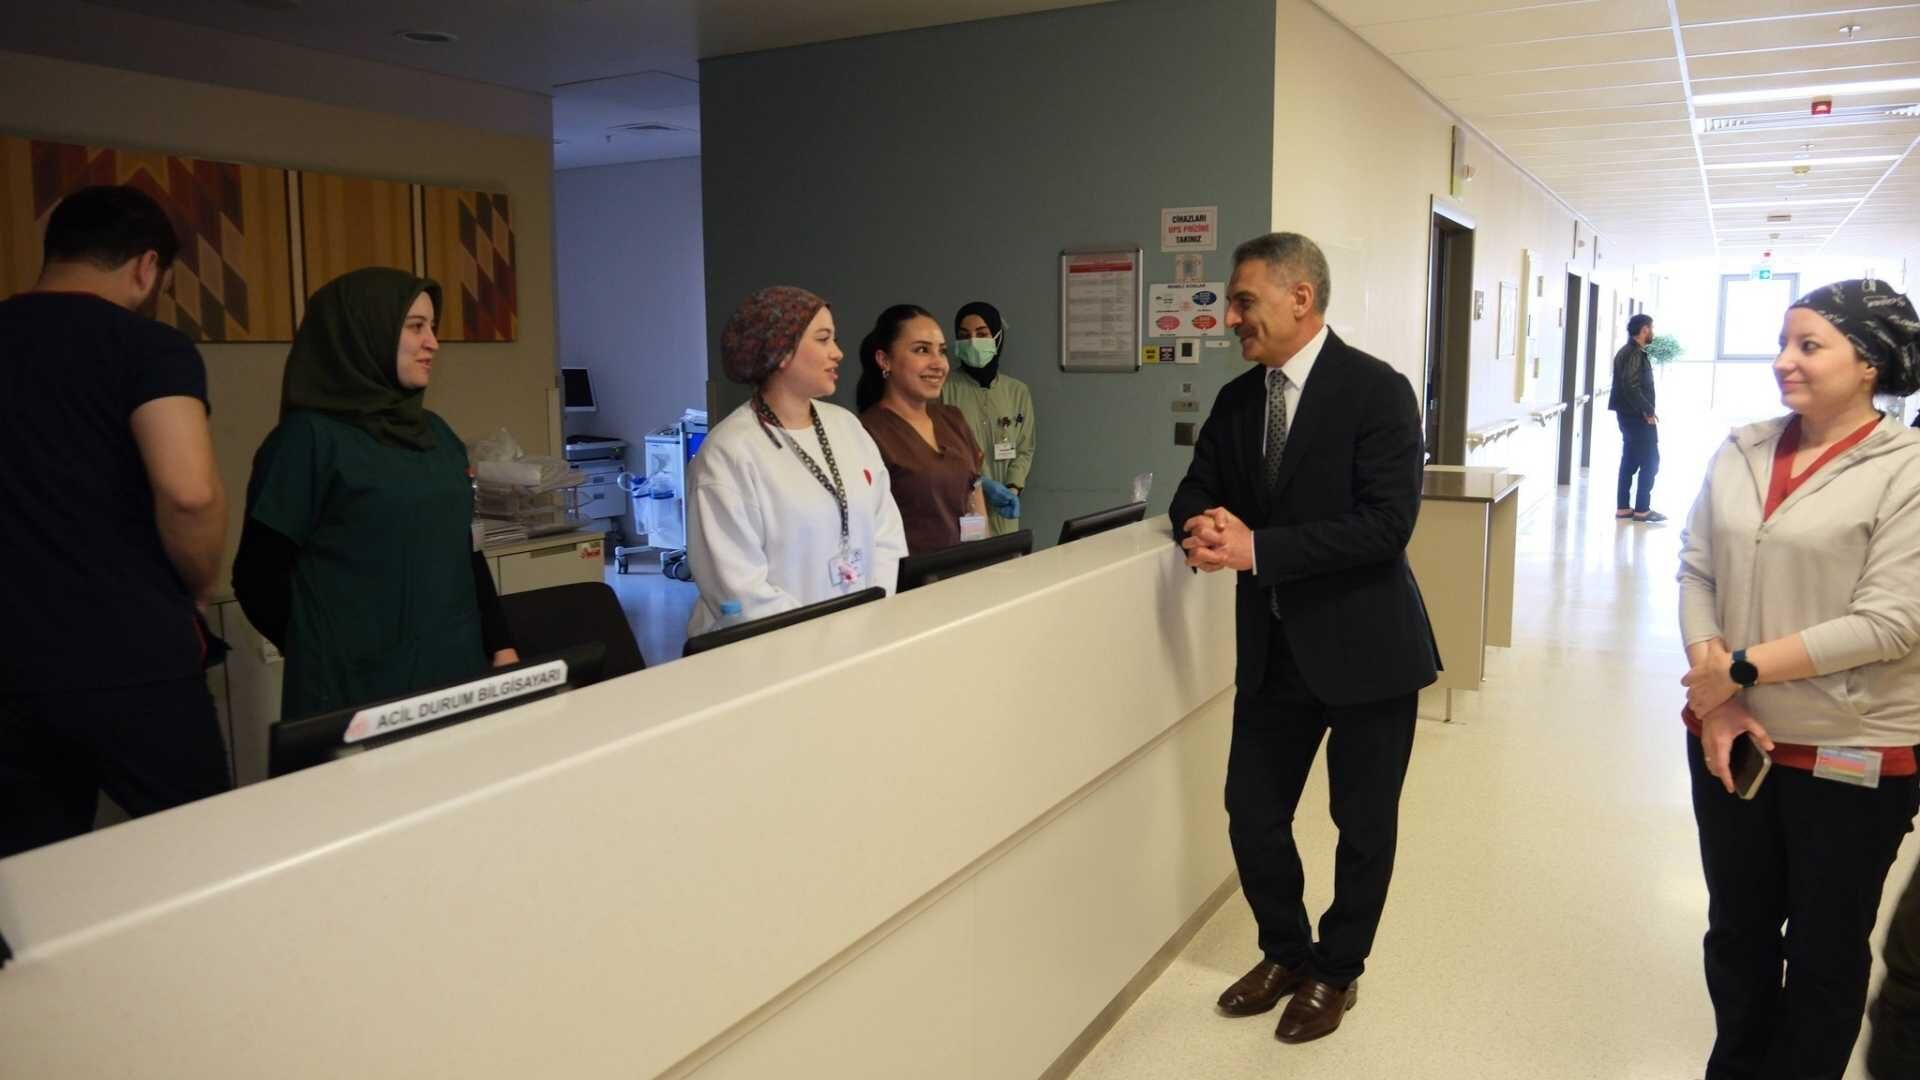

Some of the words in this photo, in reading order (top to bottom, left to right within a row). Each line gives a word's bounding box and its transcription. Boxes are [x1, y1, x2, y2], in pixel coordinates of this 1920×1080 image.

[376, 704, 414, 729] ACİL
[418, 691, 474, 718] DURUM
[478, 668, 561, 701] BİLGİSAYARI
